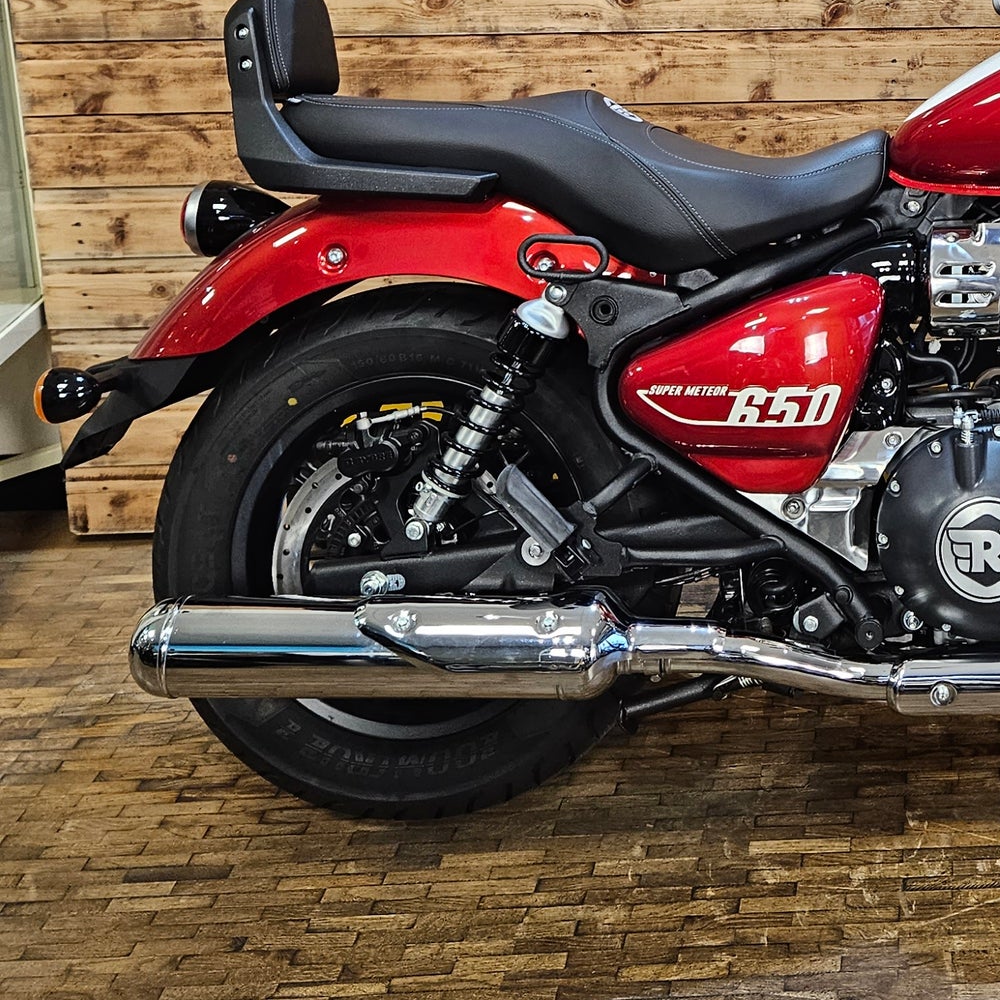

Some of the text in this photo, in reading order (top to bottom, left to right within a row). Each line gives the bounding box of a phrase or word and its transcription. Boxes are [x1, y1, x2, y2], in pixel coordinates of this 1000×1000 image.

[648, 384, 728, 396] SUPER METEOR
[726, 385, 842, 427] 650
